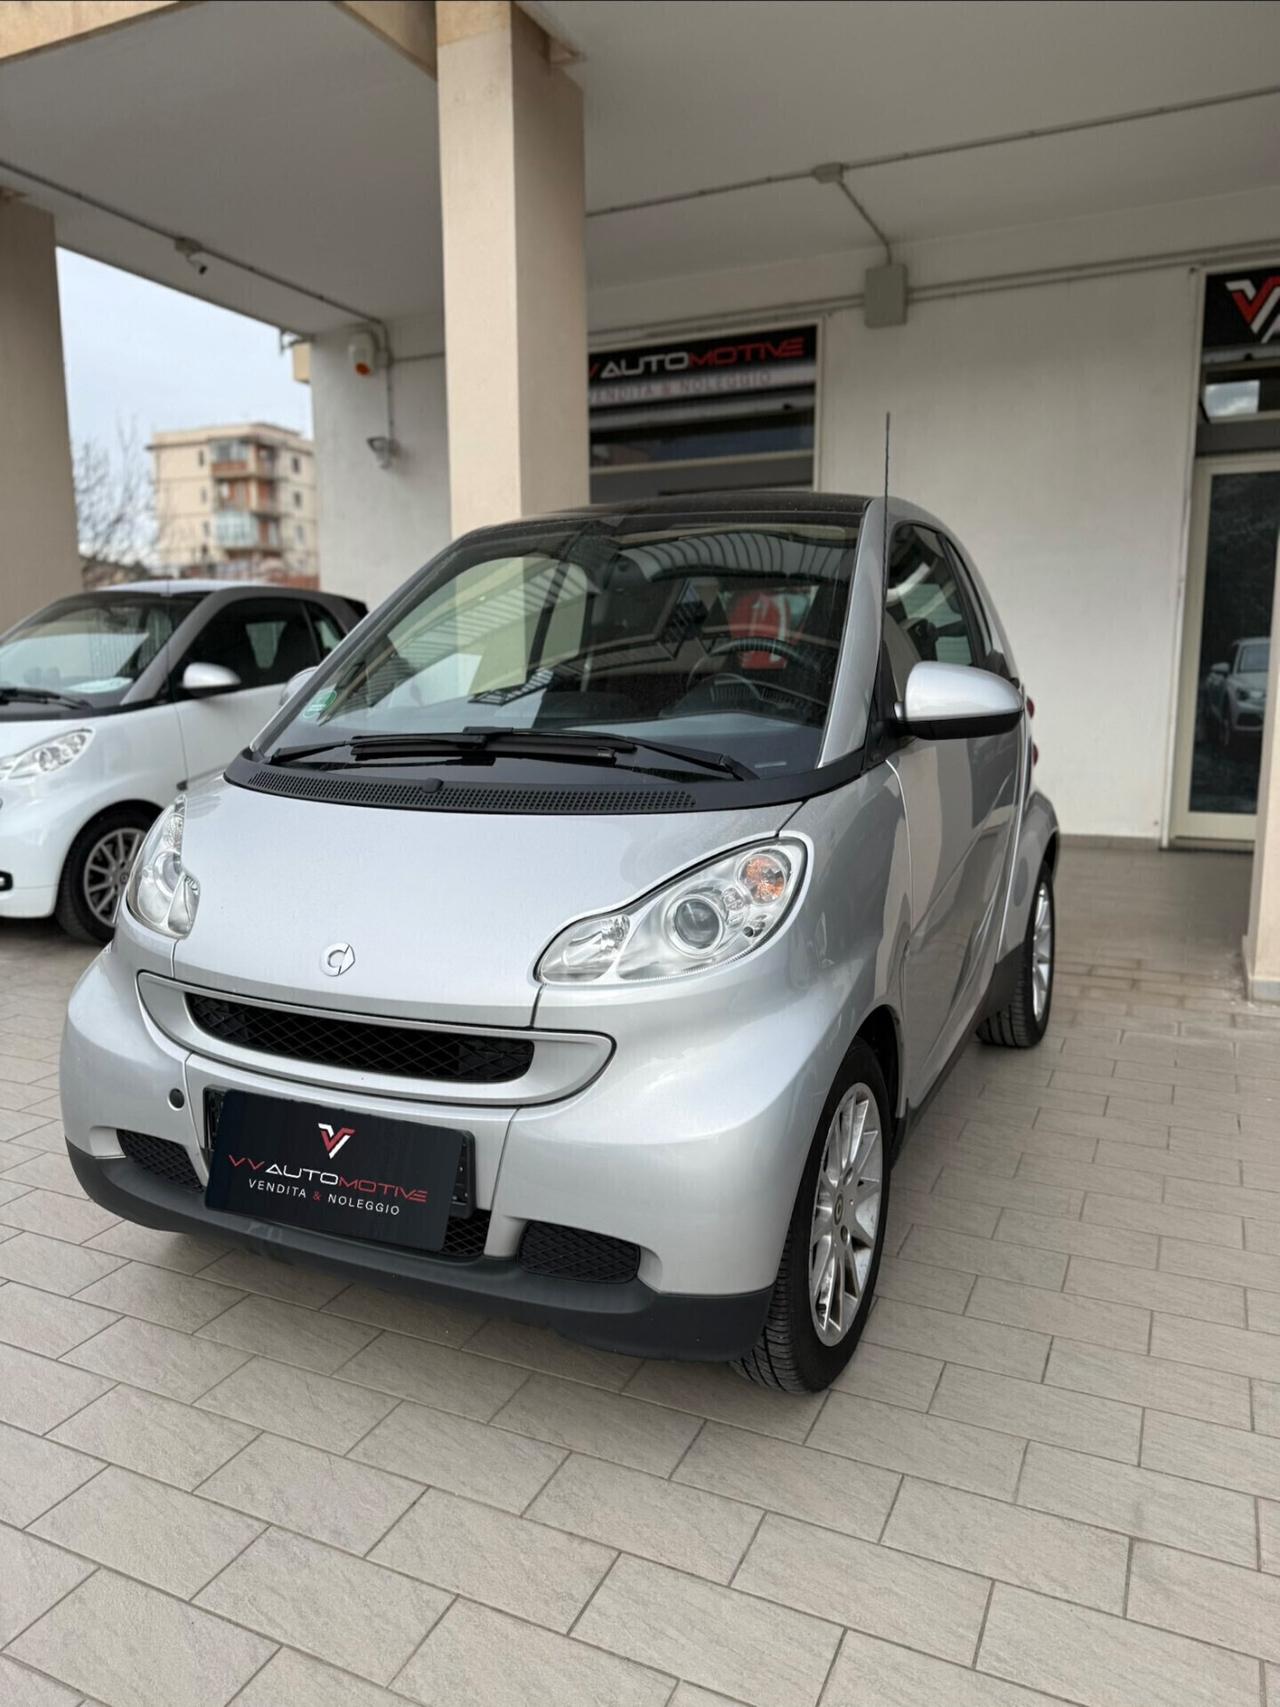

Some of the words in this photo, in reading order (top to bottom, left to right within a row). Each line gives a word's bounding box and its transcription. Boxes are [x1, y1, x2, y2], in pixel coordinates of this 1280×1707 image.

[229, 1154, 428, 1203] VVAUTOMOTIVE
[249, 1178, 307, 1199] VENDITA
[313, 1190, 321, 1201] &
[328, 1193, 400, 1216] NOLEGGIO
